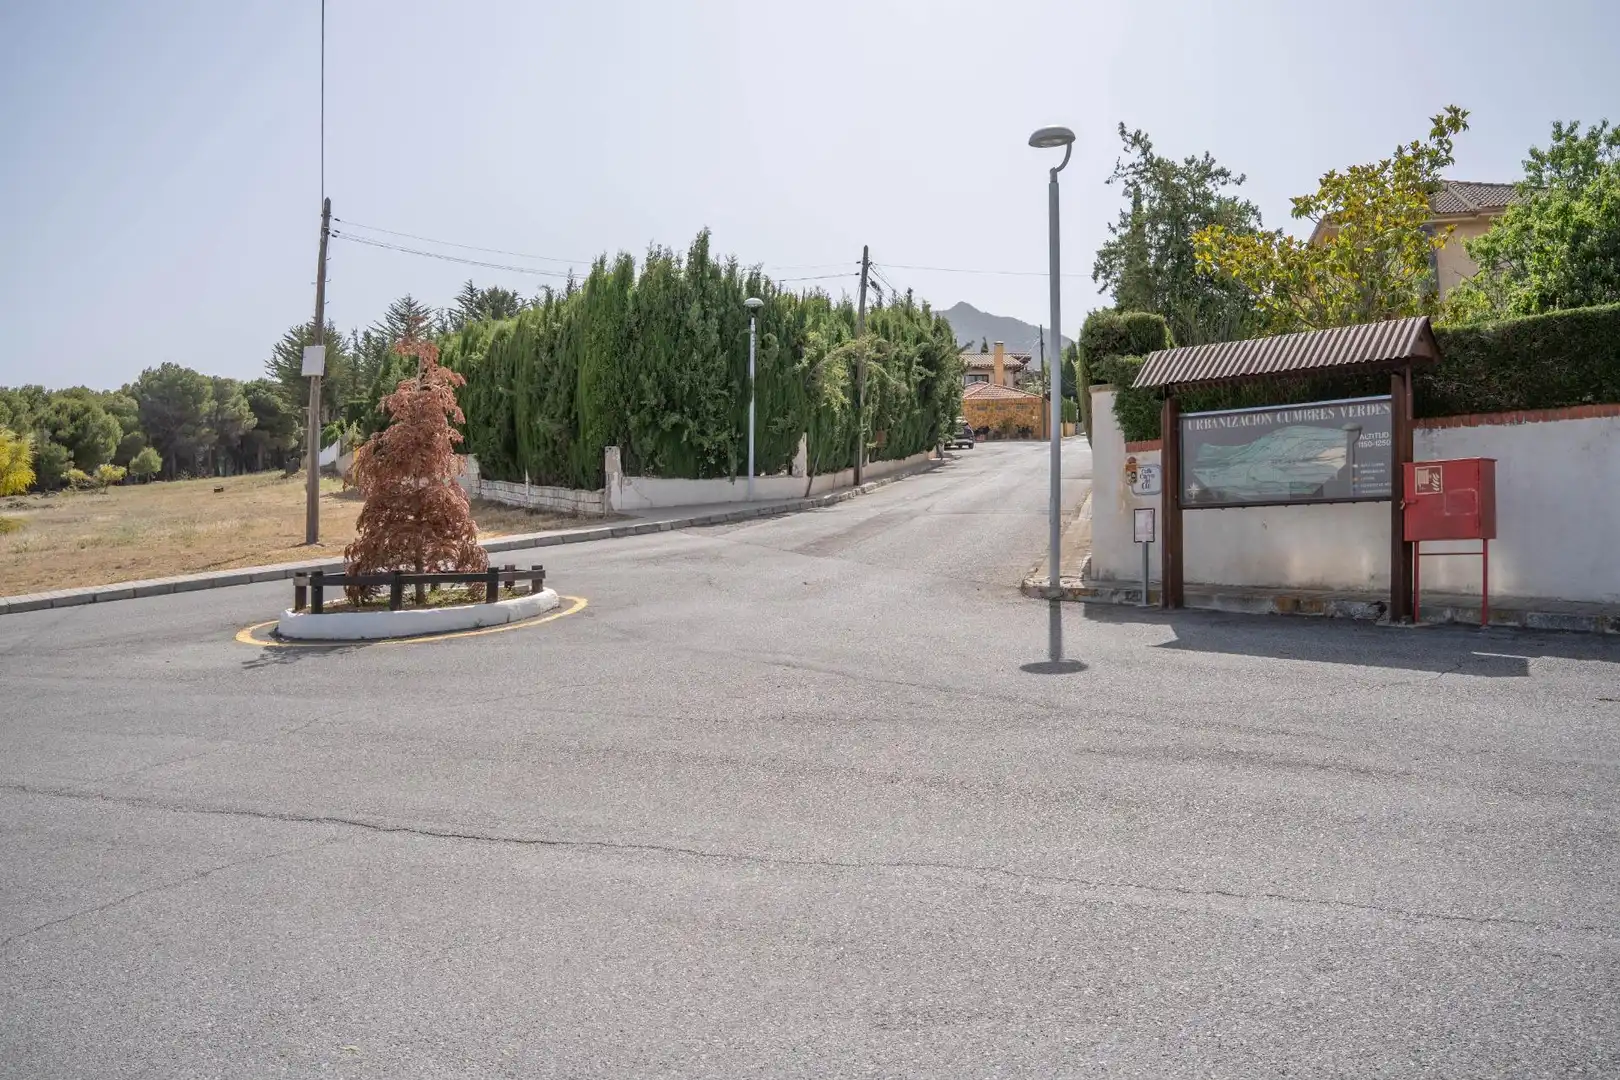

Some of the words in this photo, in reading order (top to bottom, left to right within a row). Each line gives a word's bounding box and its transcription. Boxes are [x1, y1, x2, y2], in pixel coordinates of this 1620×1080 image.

[1188, 413, 1272, 430] URBANIZACION
[1276, 407, 1334, 424] CUMBRES
[1340, 402, 1391, 418] VERDES
[1359, 431, 1390, 441] ALTITUD
